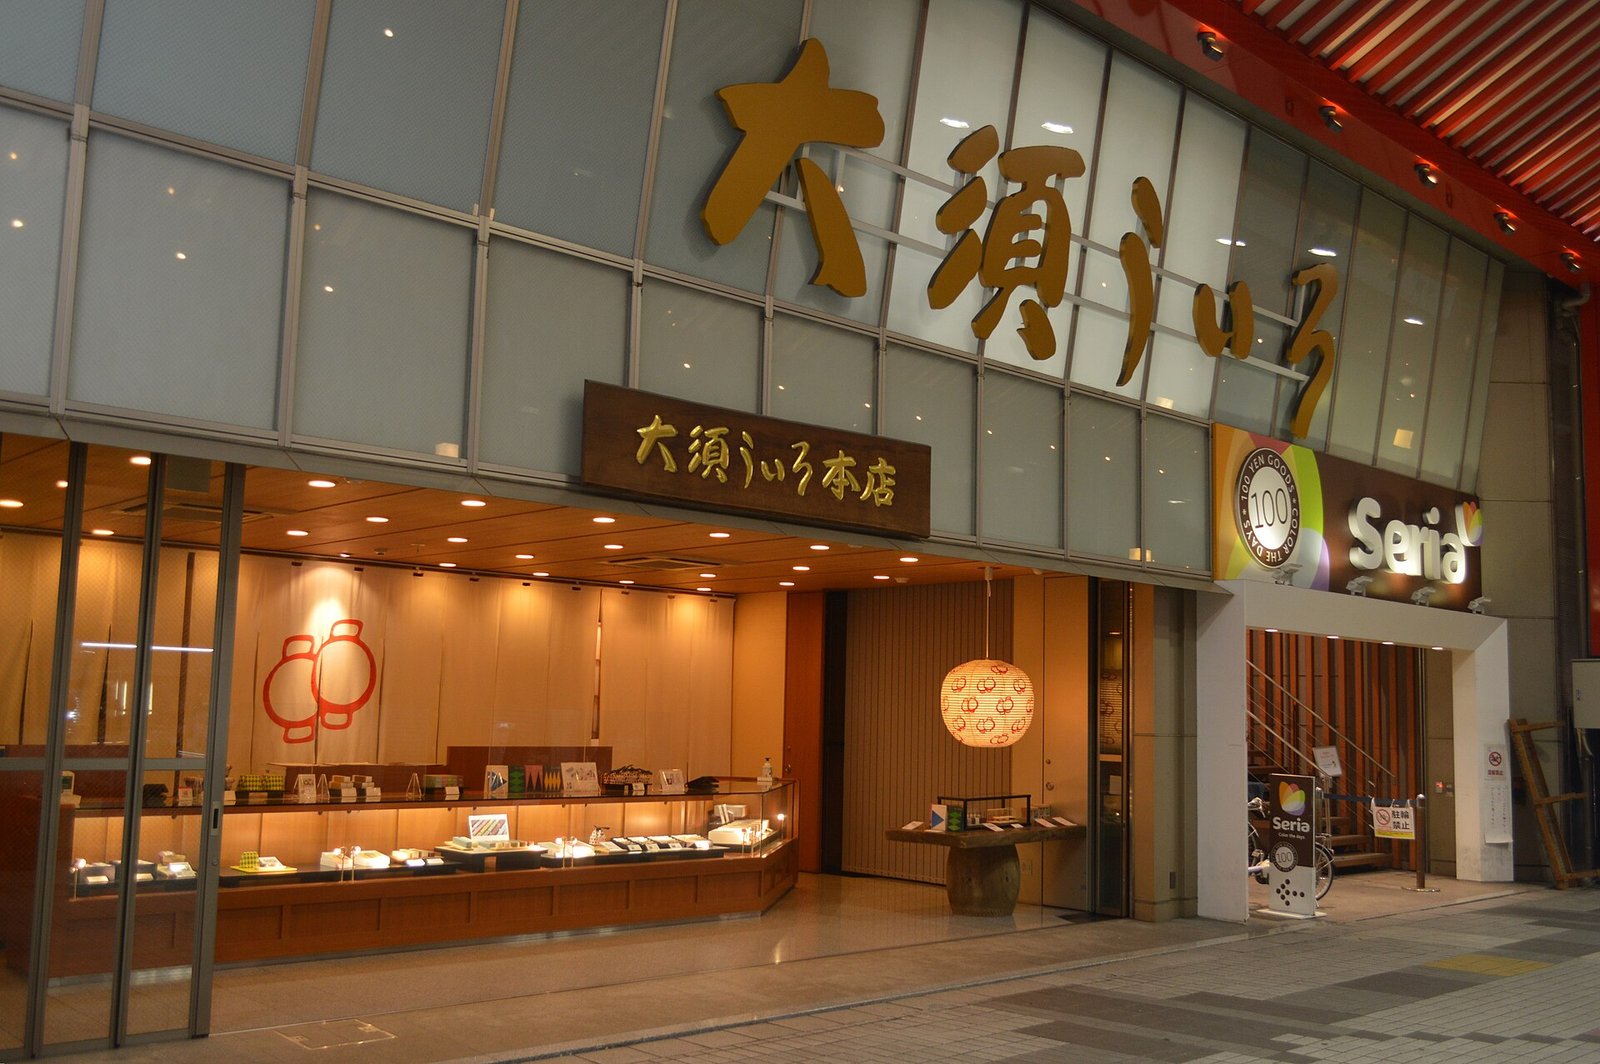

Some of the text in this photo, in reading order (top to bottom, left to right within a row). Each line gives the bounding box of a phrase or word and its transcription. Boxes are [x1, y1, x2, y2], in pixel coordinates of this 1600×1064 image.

[699, 38, 1339, 439] 大須ういろ
[635, 414, 897, 507] 大須ういろ本店
[1241, 453, 1296, 501] 100 YEN GOODS
[1250, 487, 1289, 530] 100
[1242, 506, 1300, 563] COLOR THE DAYS
[1348, 496, 1469, 584] Seria
[1272, 816, 1311, 833] Seria
[1391, 810, 1410, 819] 駐輪
[1392, 821, 1411, 830] 禁止
[1276, 851, 1292, 863] 100
